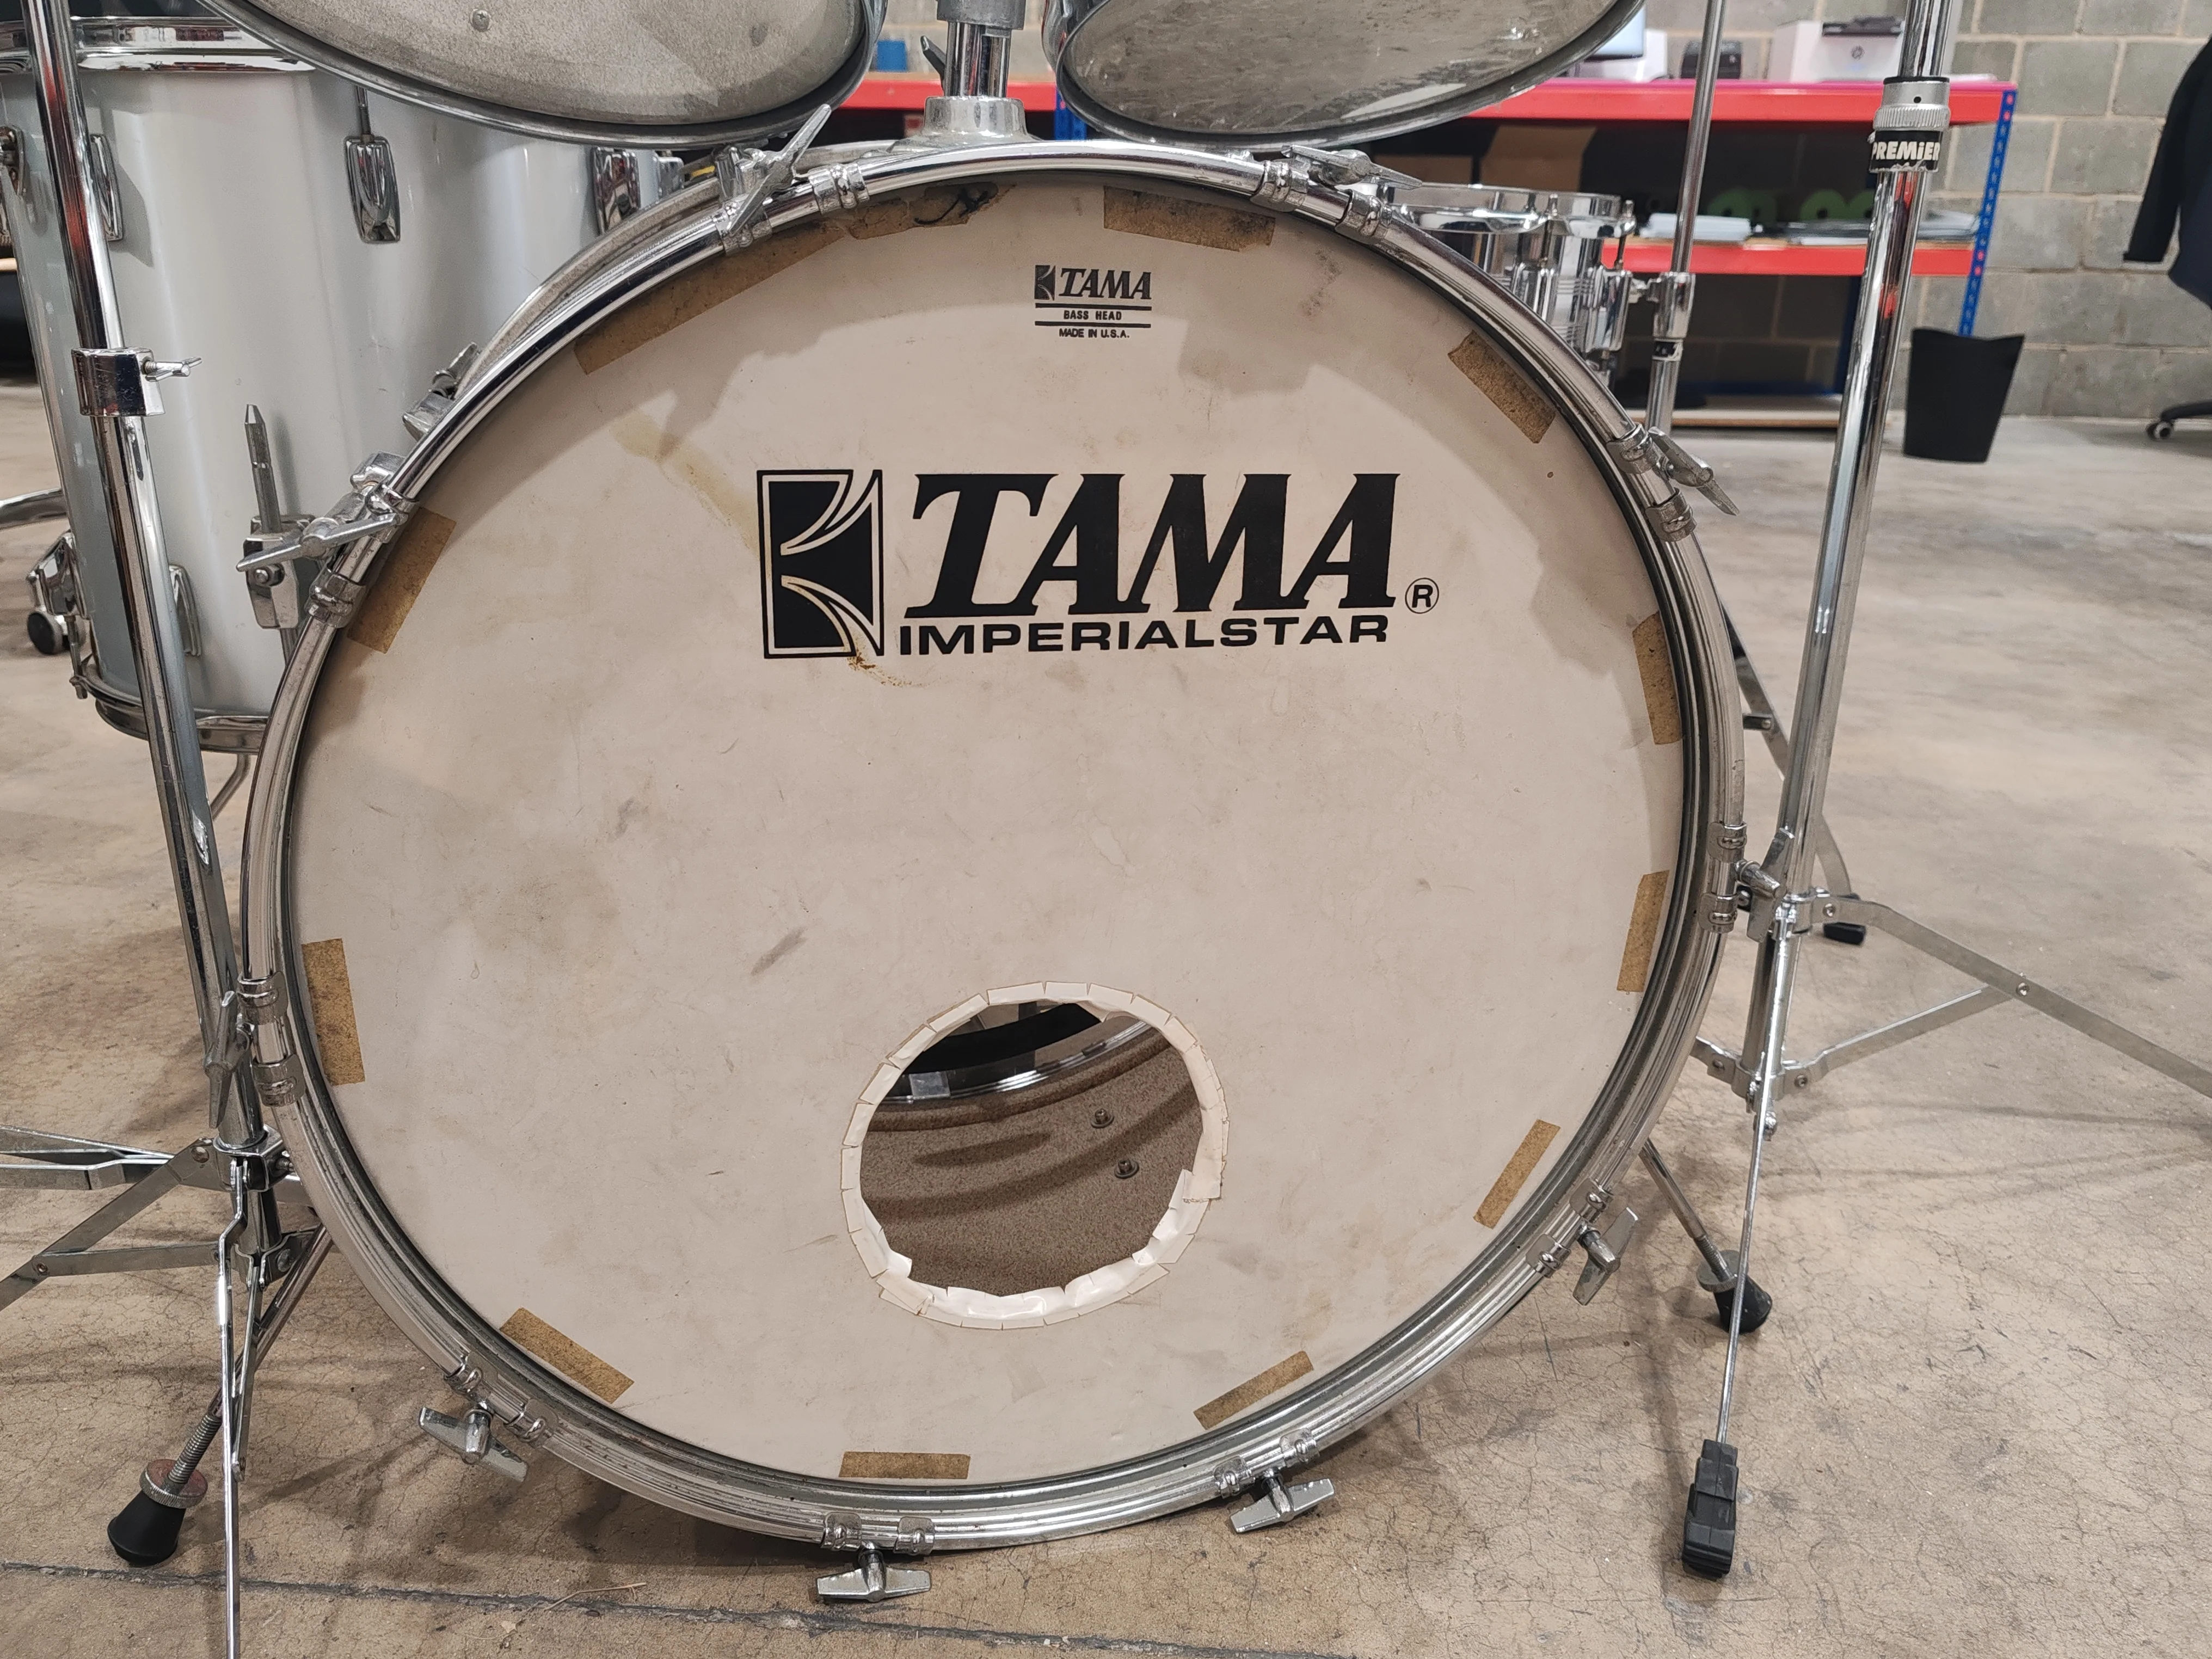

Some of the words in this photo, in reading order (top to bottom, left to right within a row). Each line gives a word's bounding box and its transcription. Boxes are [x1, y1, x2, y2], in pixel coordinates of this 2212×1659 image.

[1059, 268, 1152, 299] TAMA
[1064, 310, 1089, 319] BASS
[1095, 311, 1122, 320] HEAD
[1059, 328, 1085, 337] MADE
[1088, 329, 1097, 337] IN
[1100, 329, 1130, 338] U.S.A.
[904, 474, 1400, 618] TAMA
[900, 615, 1388, 655] IMPERIALSTAR
